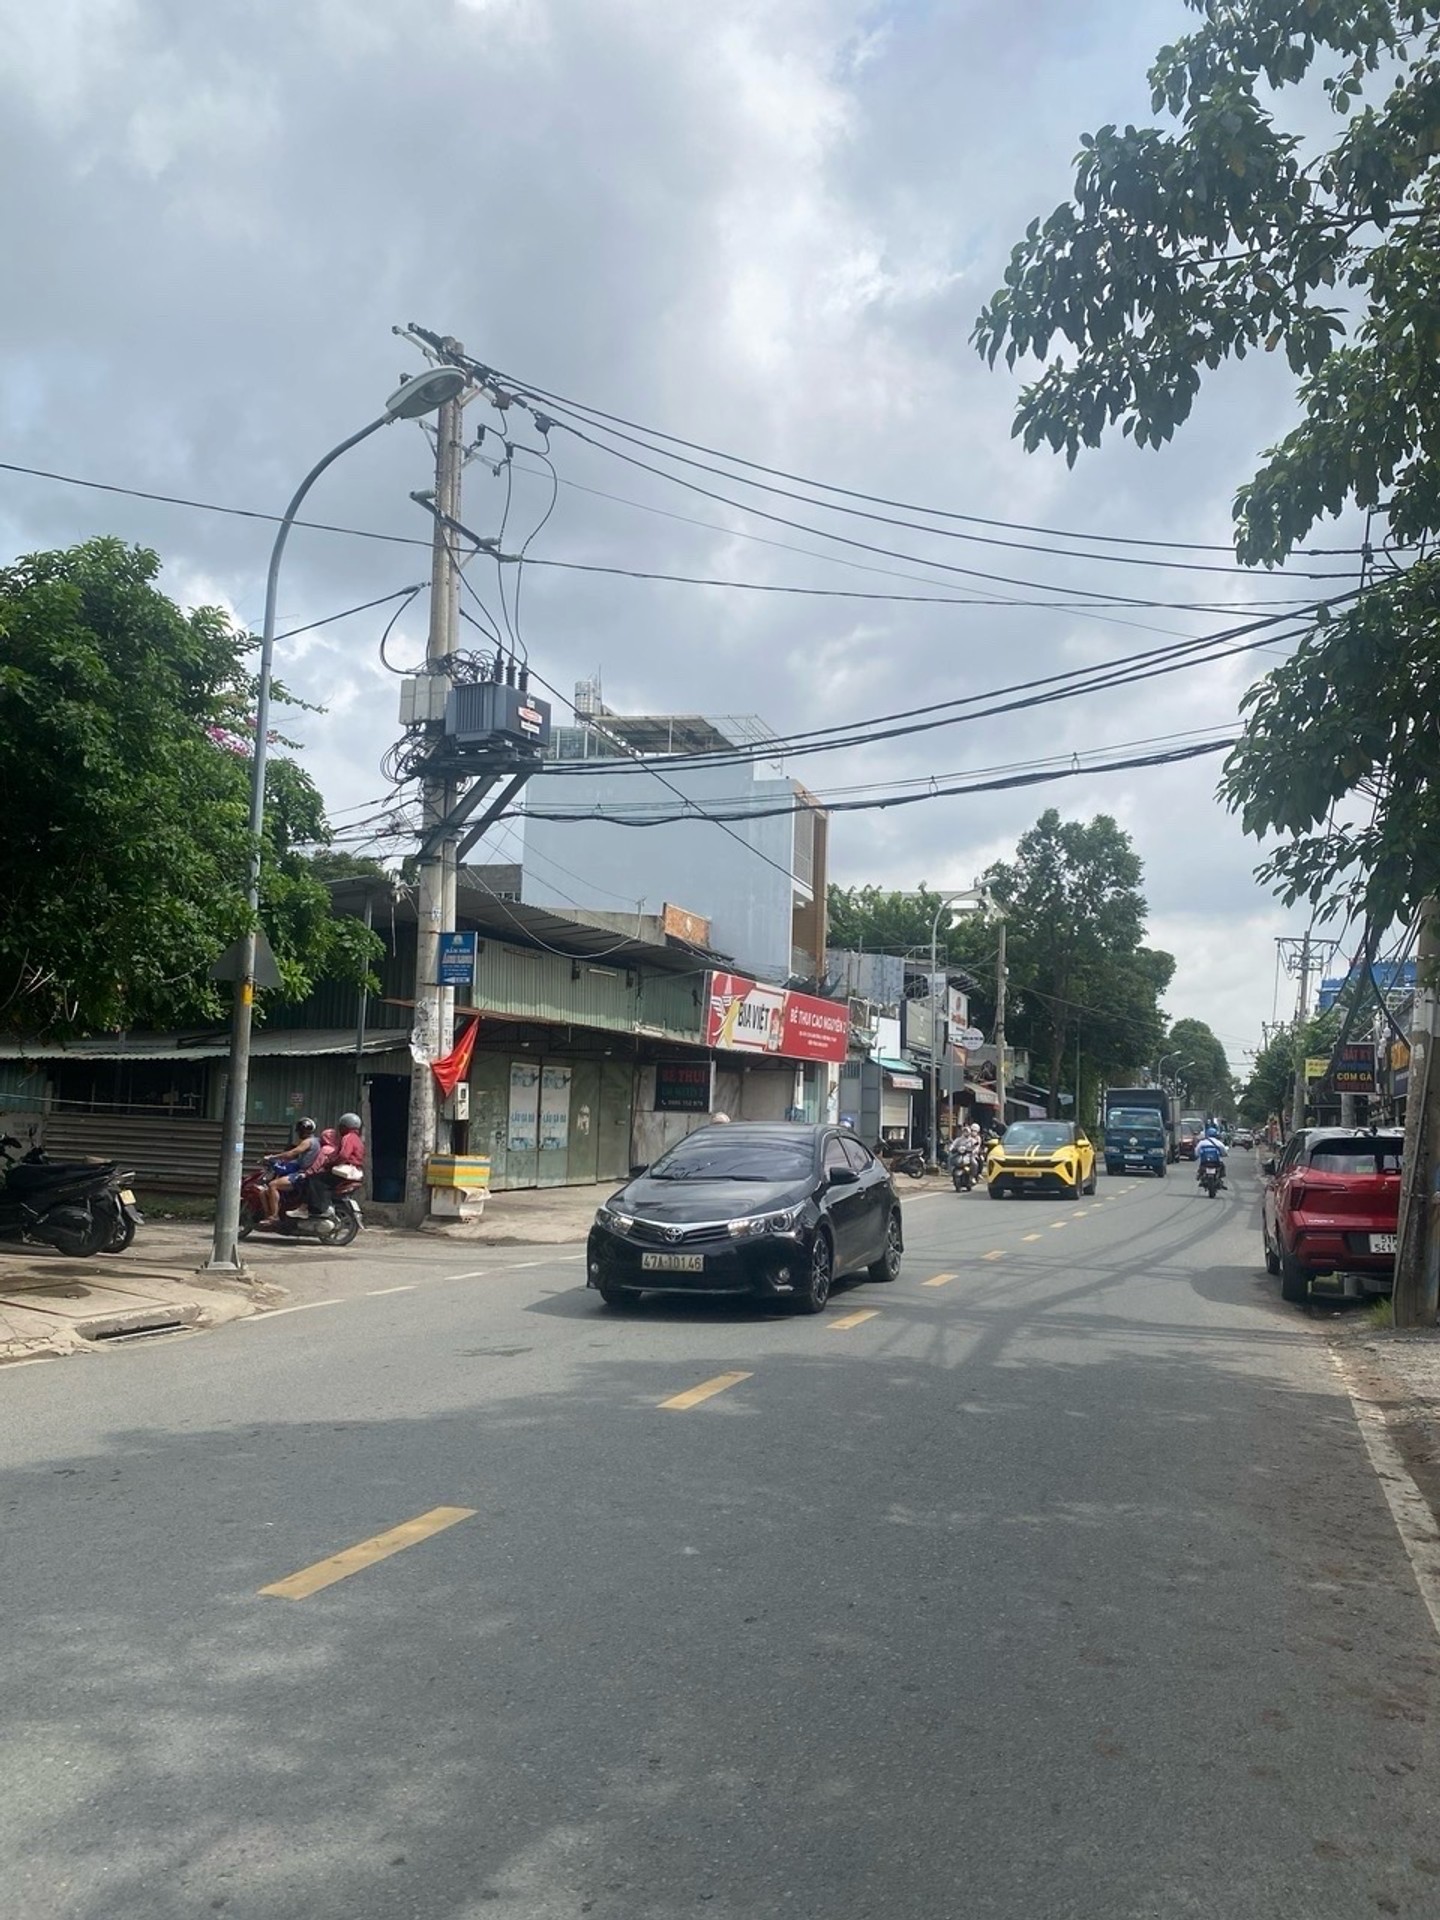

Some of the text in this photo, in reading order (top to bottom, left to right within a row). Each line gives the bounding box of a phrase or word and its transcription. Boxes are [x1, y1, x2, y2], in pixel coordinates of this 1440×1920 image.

[738, 1002, 770, 1033] BIA VIỆT
[1359, 1070, 1372, 1081] GÀ
